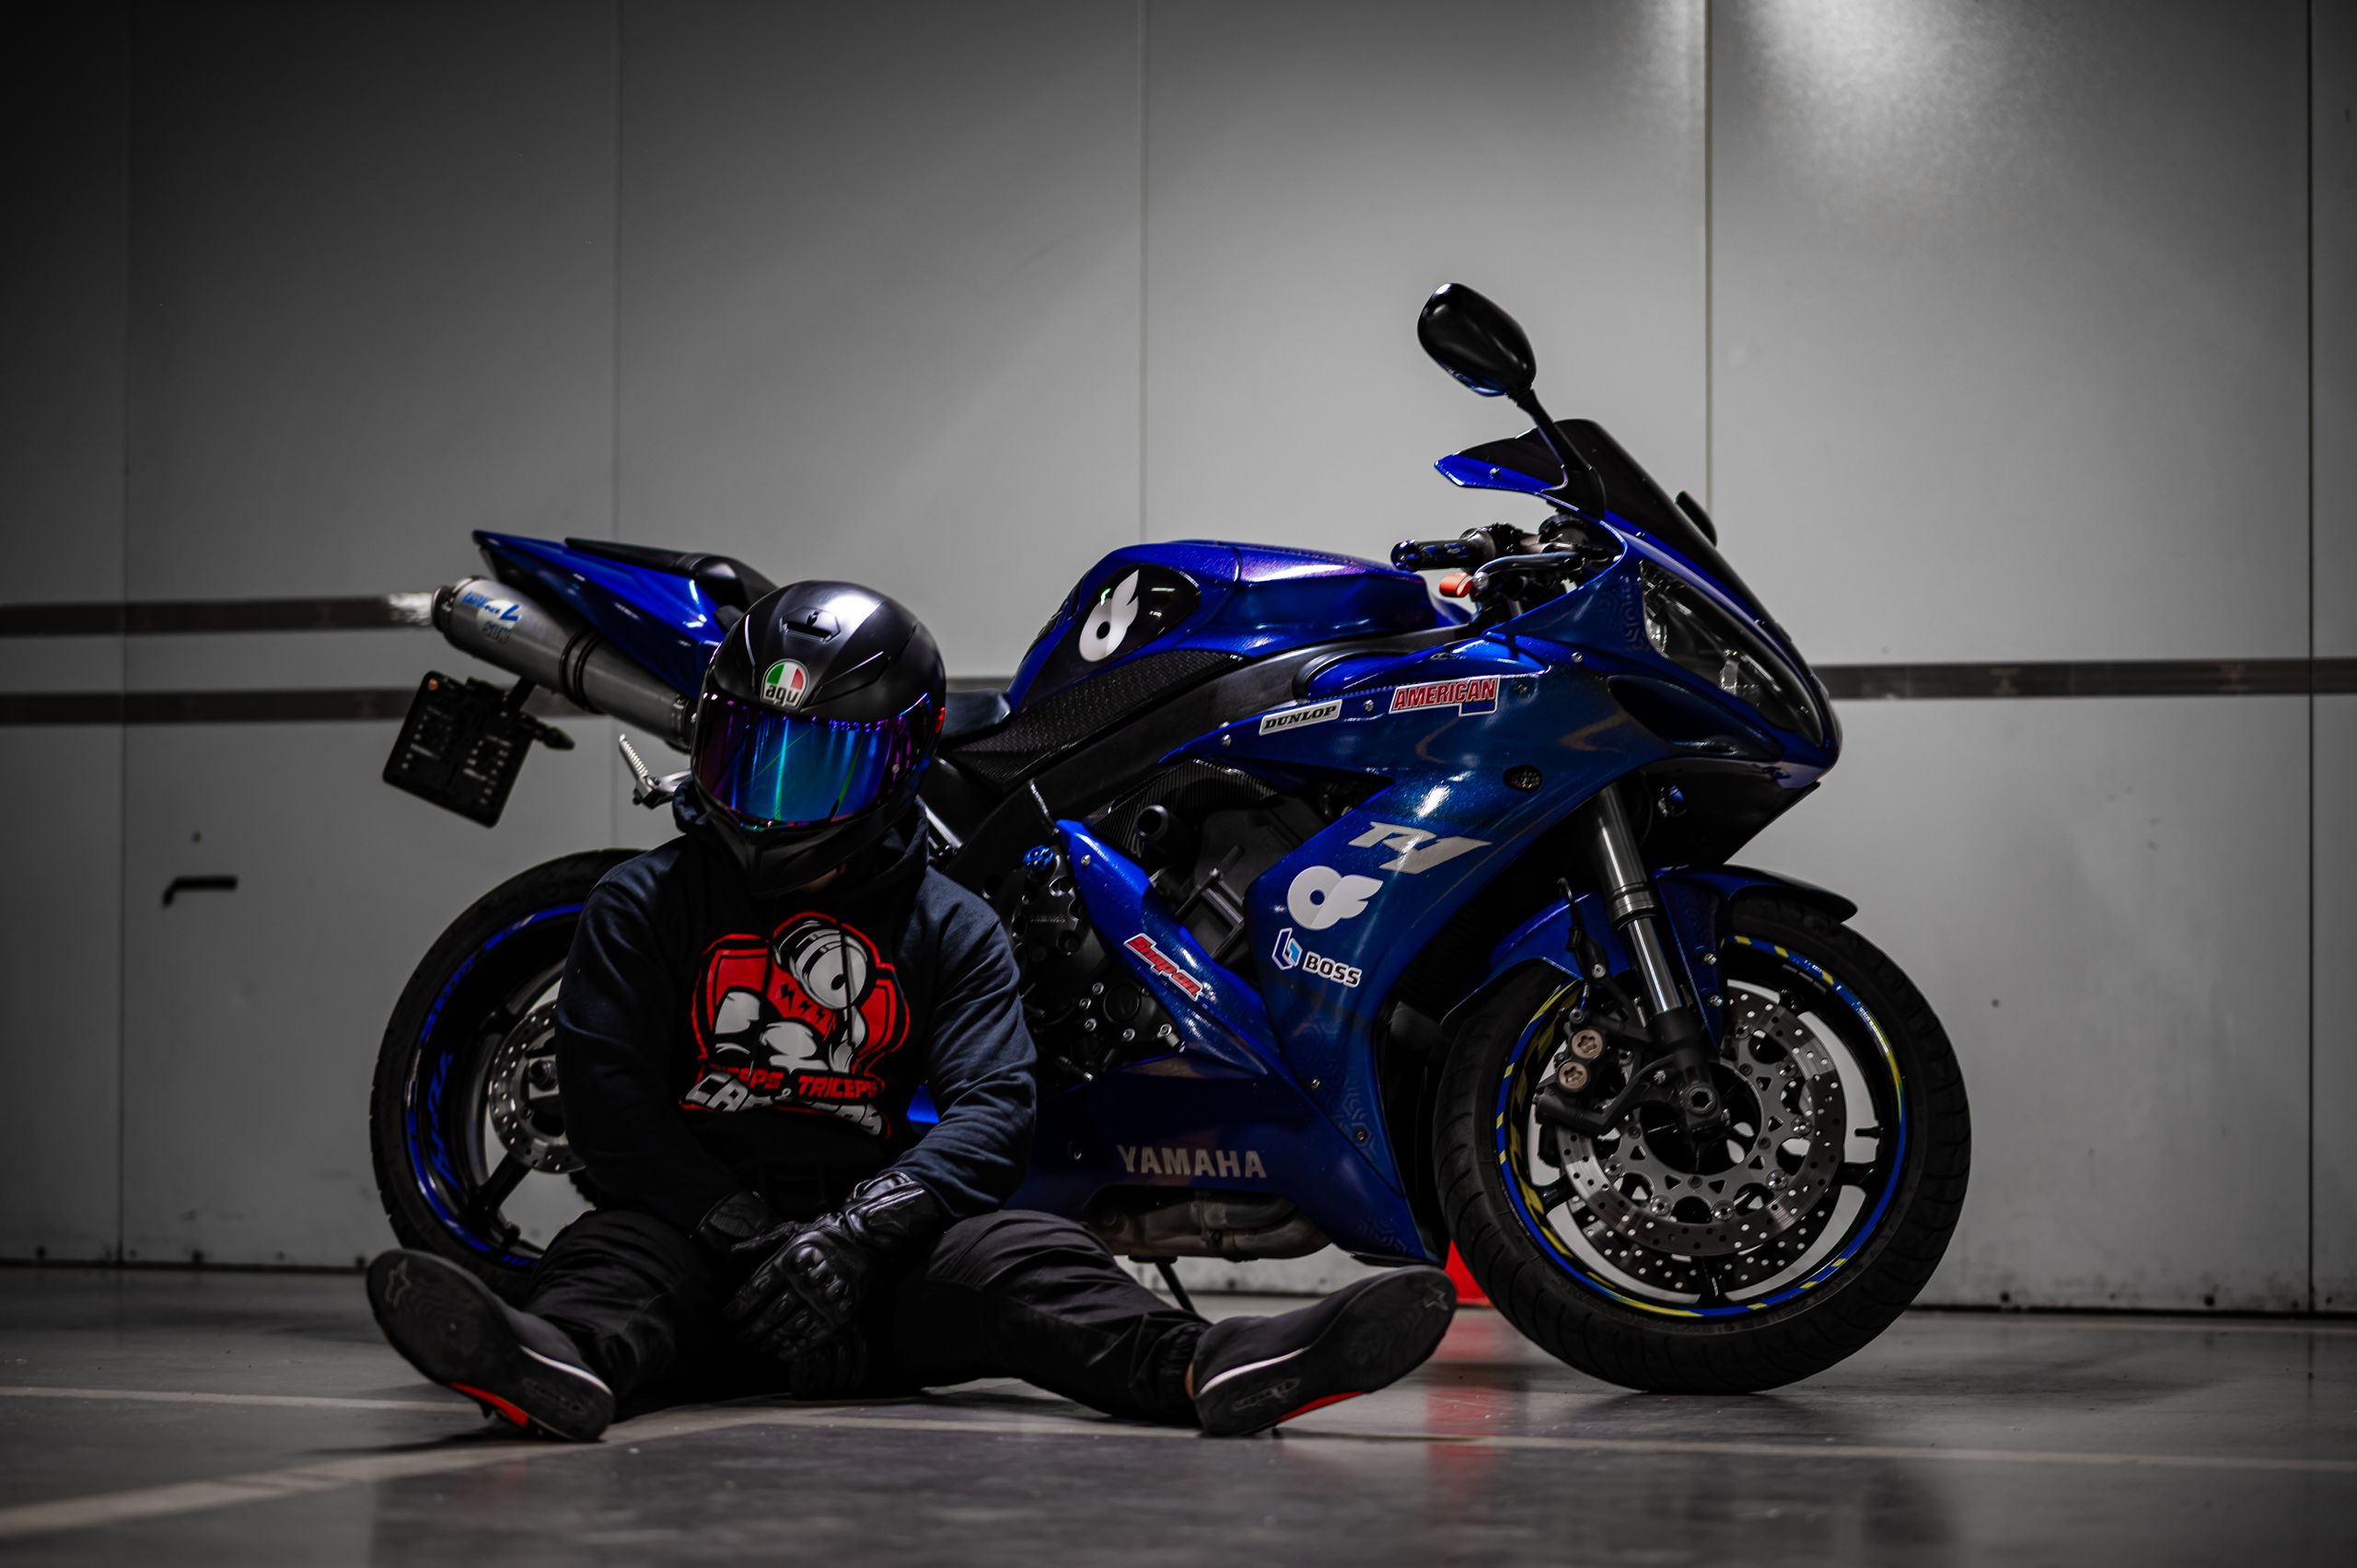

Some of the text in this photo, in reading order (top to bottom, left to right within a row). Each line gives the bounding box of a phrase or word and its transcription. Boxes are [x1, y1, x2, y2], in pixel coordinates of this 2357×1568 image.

[1392, 680, 1496, 711] AMERICAN
[1263, 705, 1337, 730] DUNLOP
[1304, 954, 1362, 986] BOSS
[1116, 1144, 1268, 1179] YAMAHA
